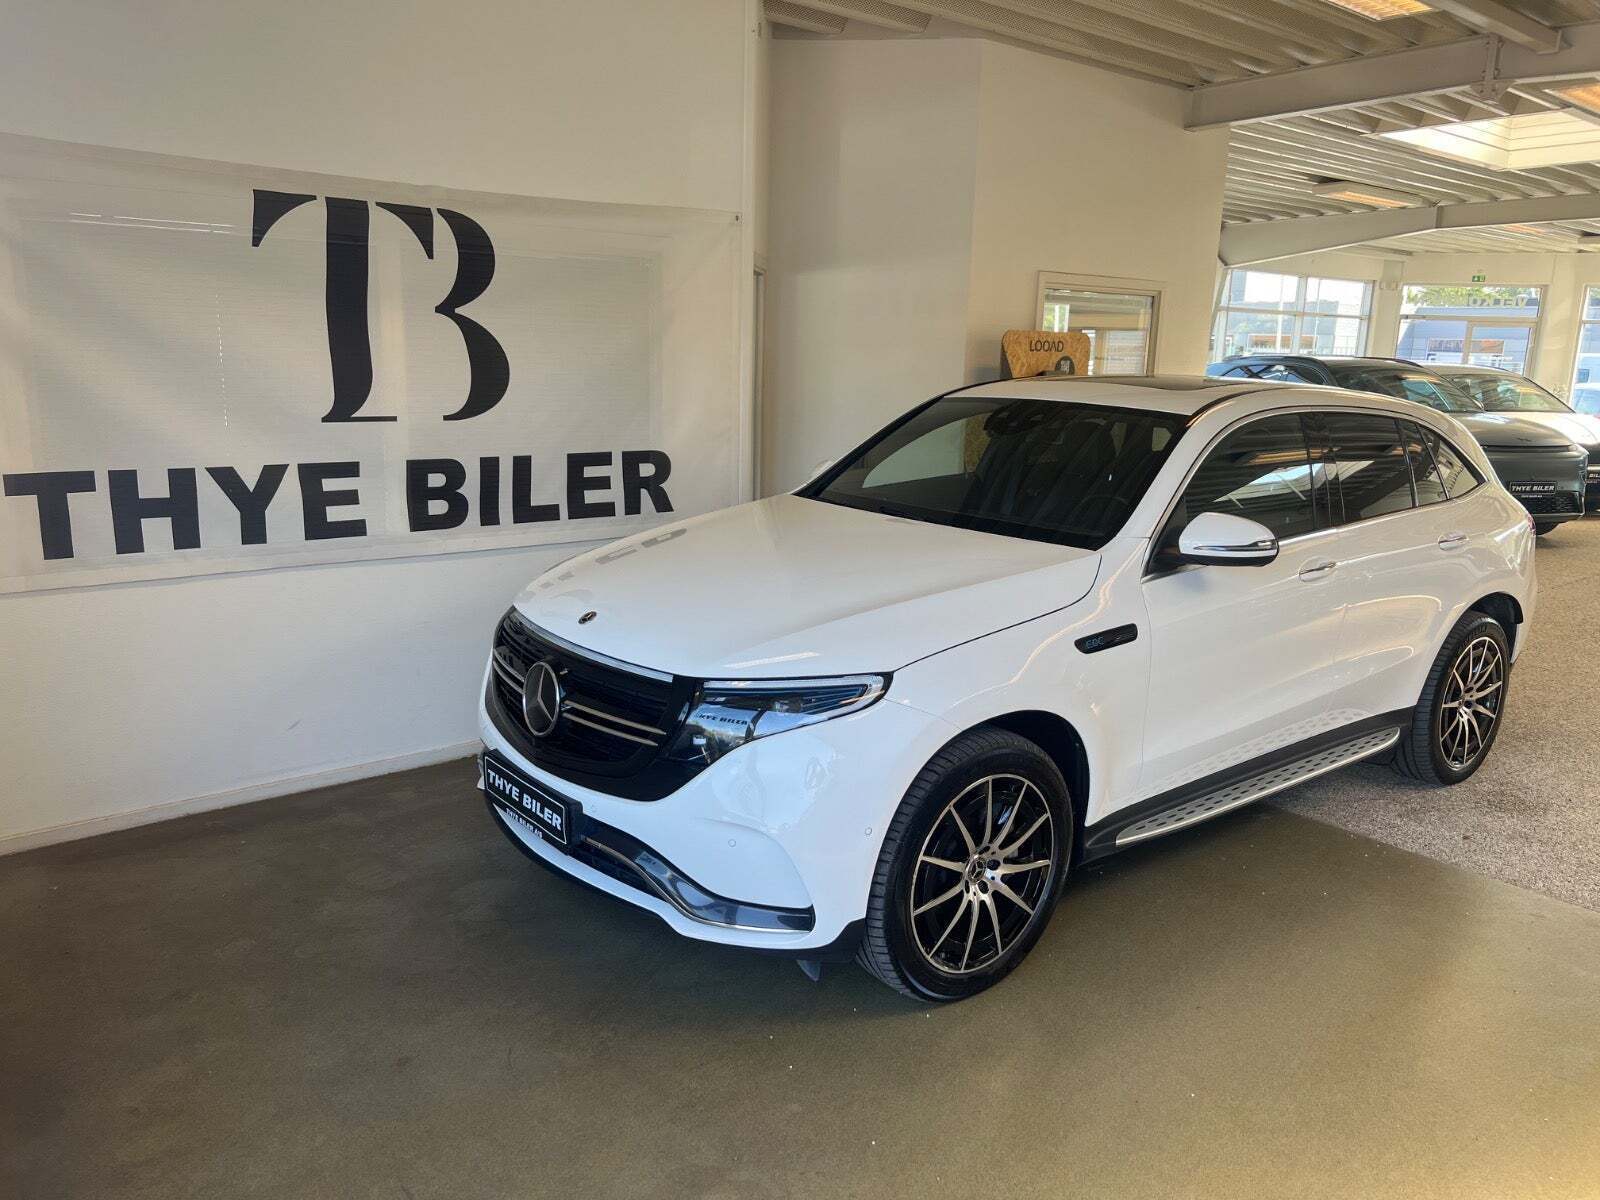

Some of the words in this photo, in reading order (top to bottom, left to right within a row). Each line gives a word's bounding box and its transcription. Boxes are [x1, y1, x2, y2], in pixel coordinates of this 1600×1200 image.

[1029, 340, 1064, 352] LOOAD
[3, 460, 367, 560] THYE
[406, 449, 674, 532] BILER
[487, 768, 519, 801] THYE
[522, 792, 562, 831] BILER
